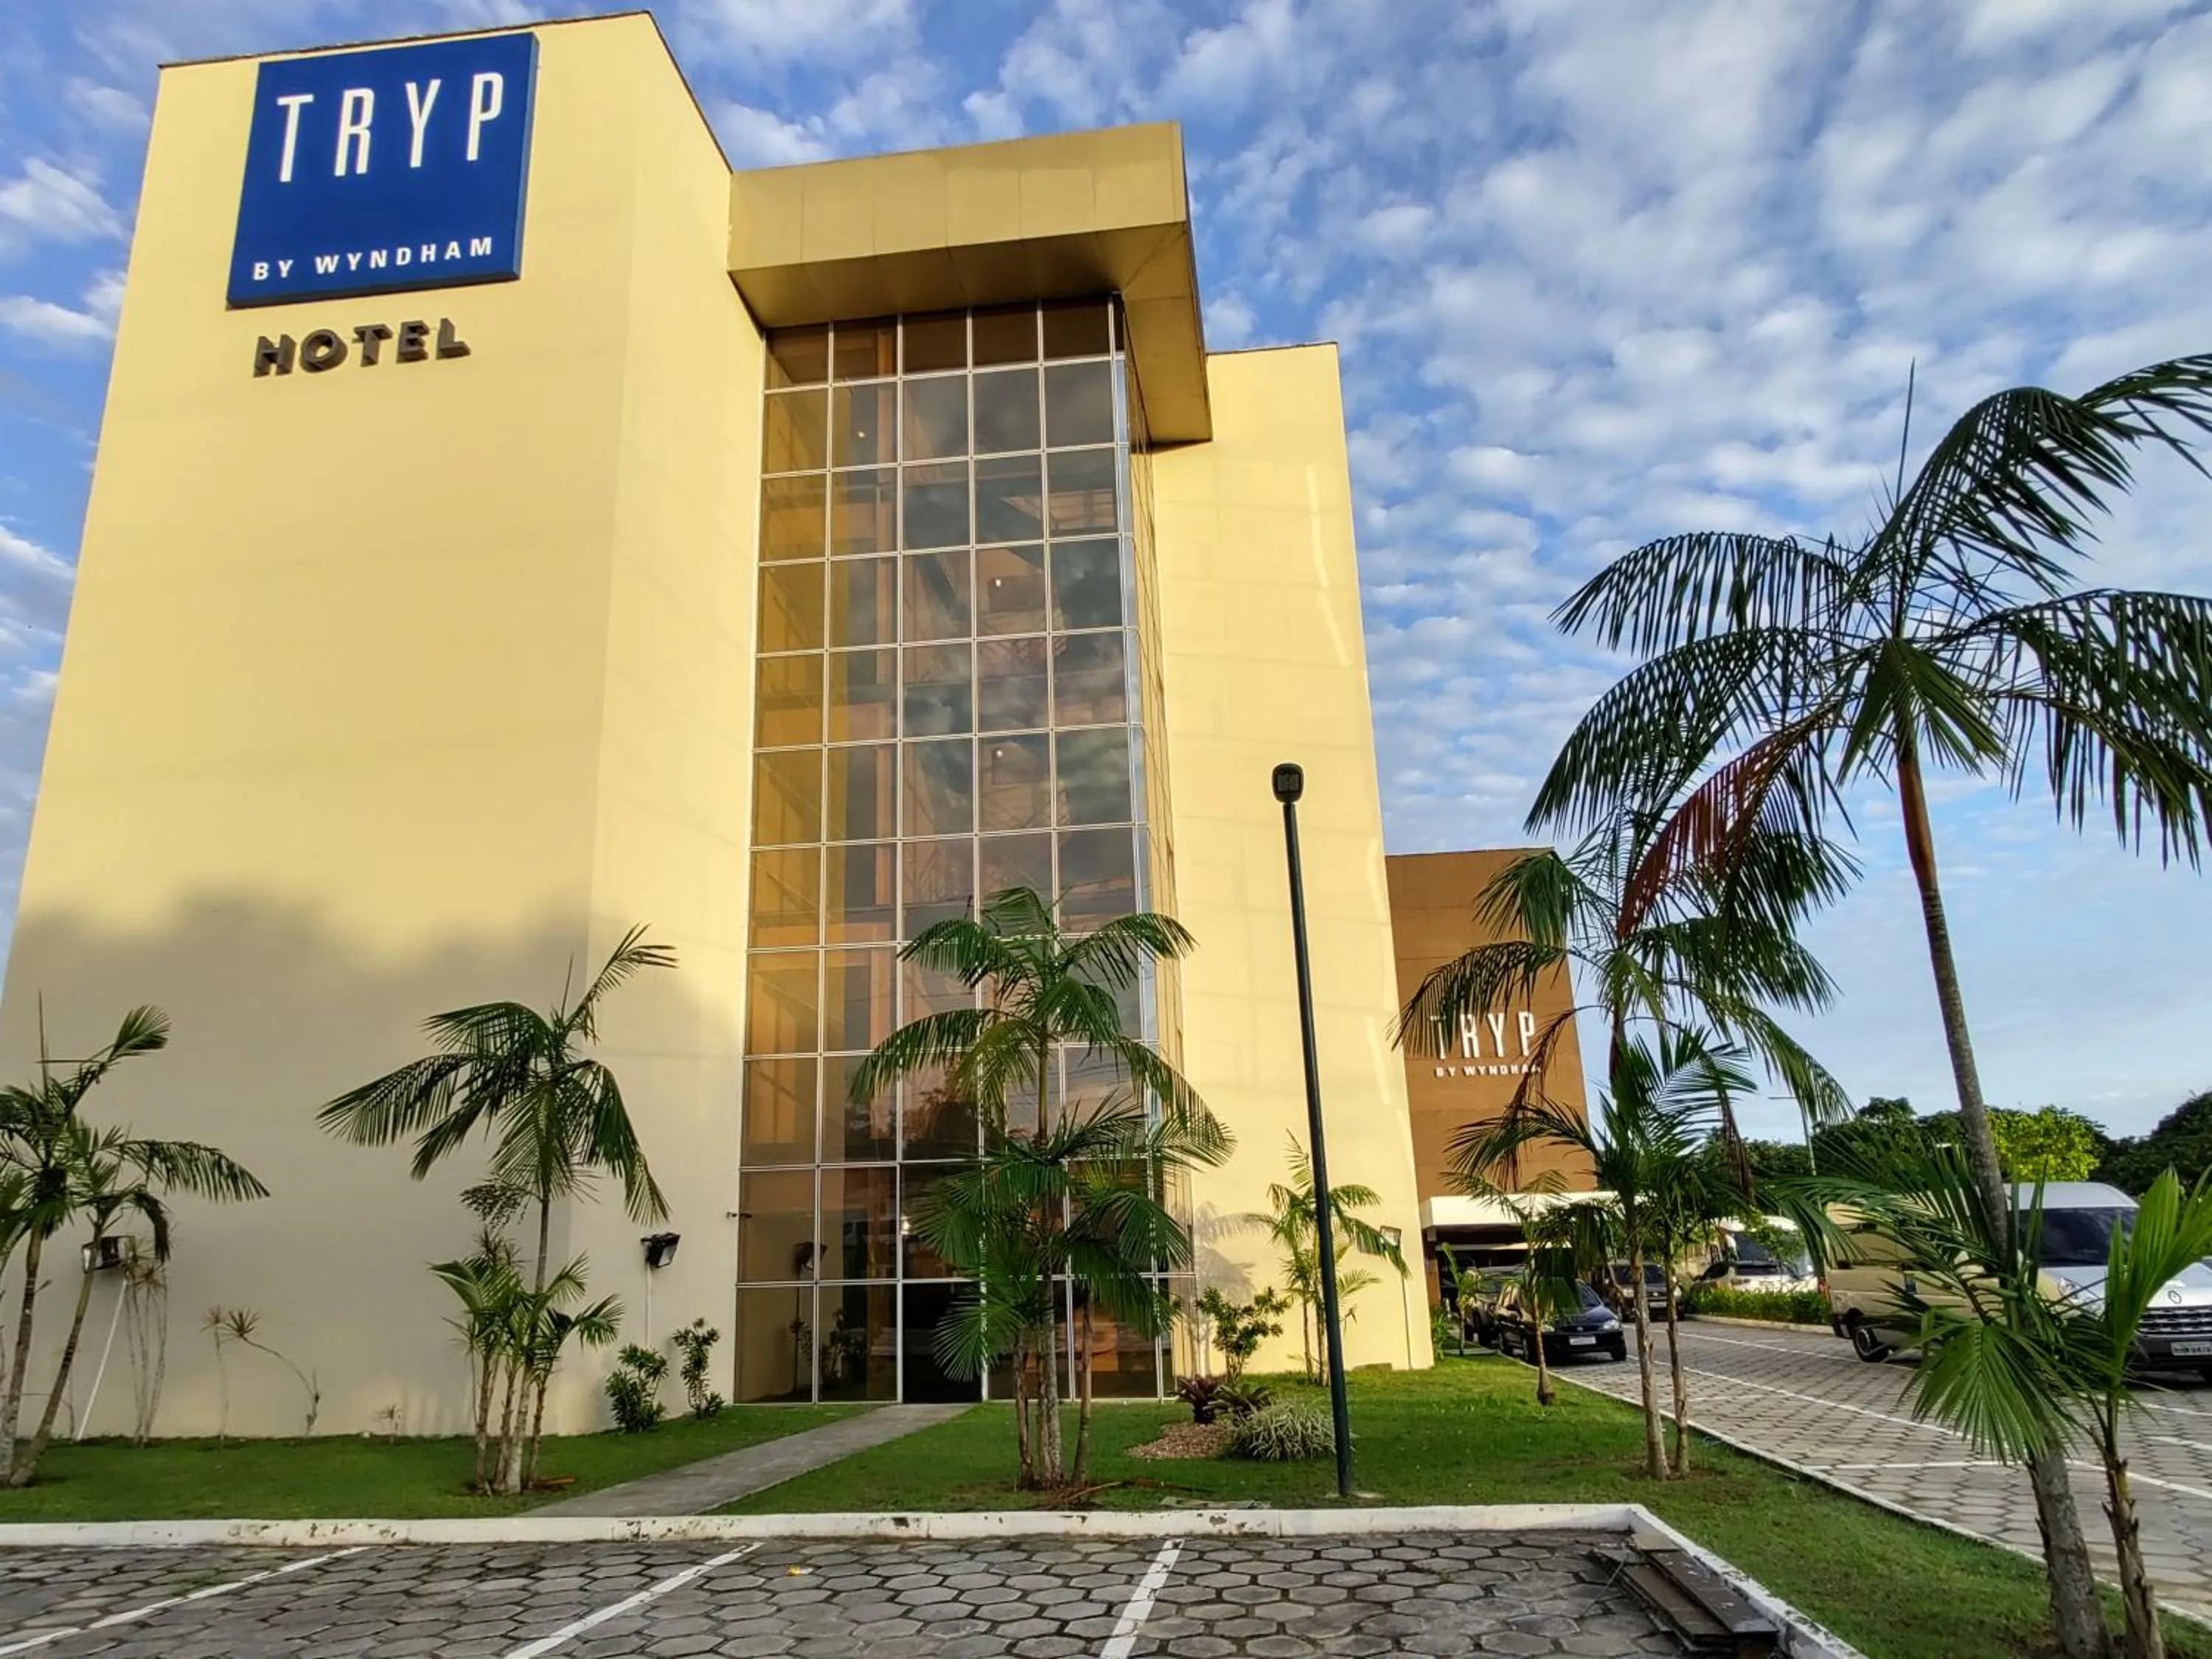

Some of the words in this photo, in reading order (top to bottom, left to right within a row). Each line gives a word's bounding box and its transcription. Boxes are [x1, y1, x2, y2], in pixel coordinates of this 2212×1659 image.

[276, 72, 504, 183] TRYP
[253, 260, 293, 280] BY
[315, 237, 493, 275] WYNDHAM
[253, 317, 470, 378] HOTEL
[1436, 1066, 1456, 1077] BY
